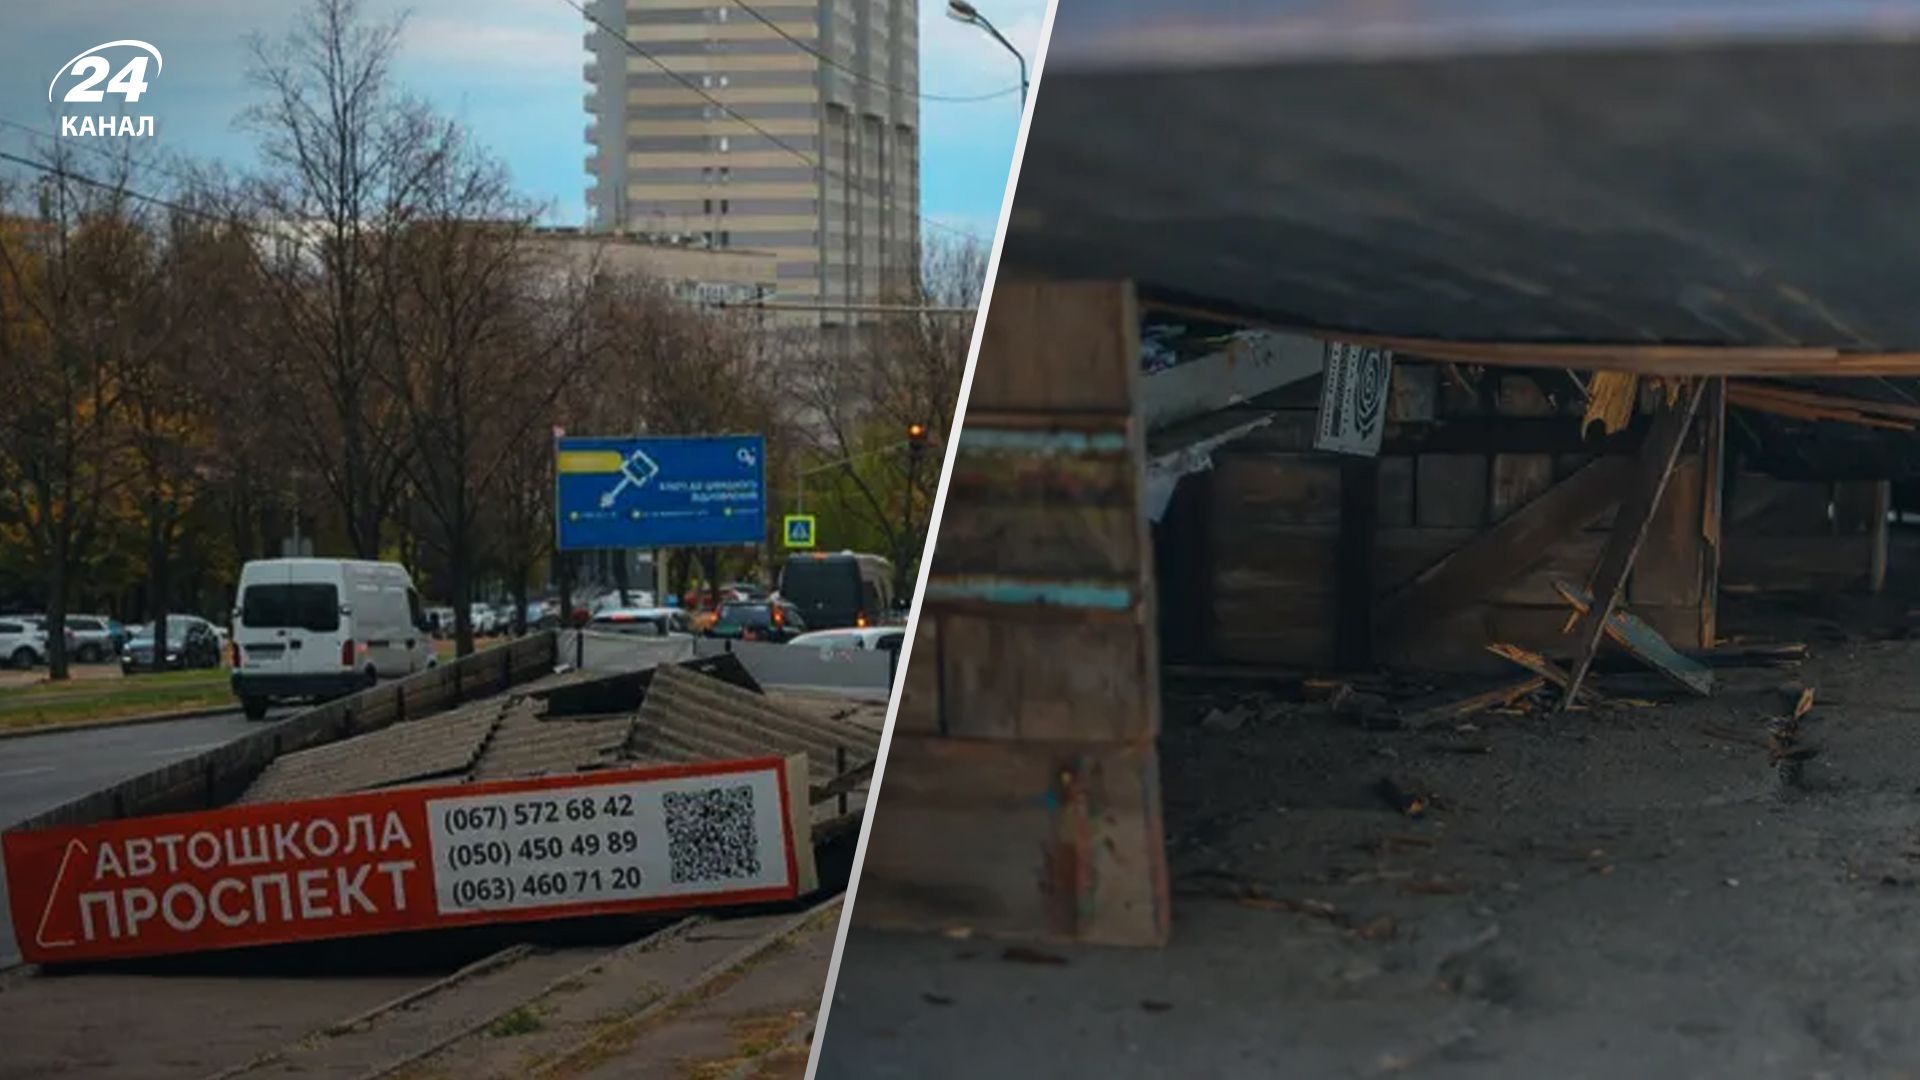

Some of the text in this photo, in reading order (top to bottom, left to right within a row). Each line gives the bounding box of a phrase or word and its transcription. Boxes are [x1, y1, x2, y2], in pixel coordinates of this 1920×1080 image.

[444, 794, 635, 836] (067) 572 68 42
[95, 811, 412, 880] АВТОШКОЛА
[448, 830, 638, 872] (050) 450 49 89
[79, 860, 416, 941] ПРОСПЕКТ
[452, 866, 642, 907] (063) 460 71 20
